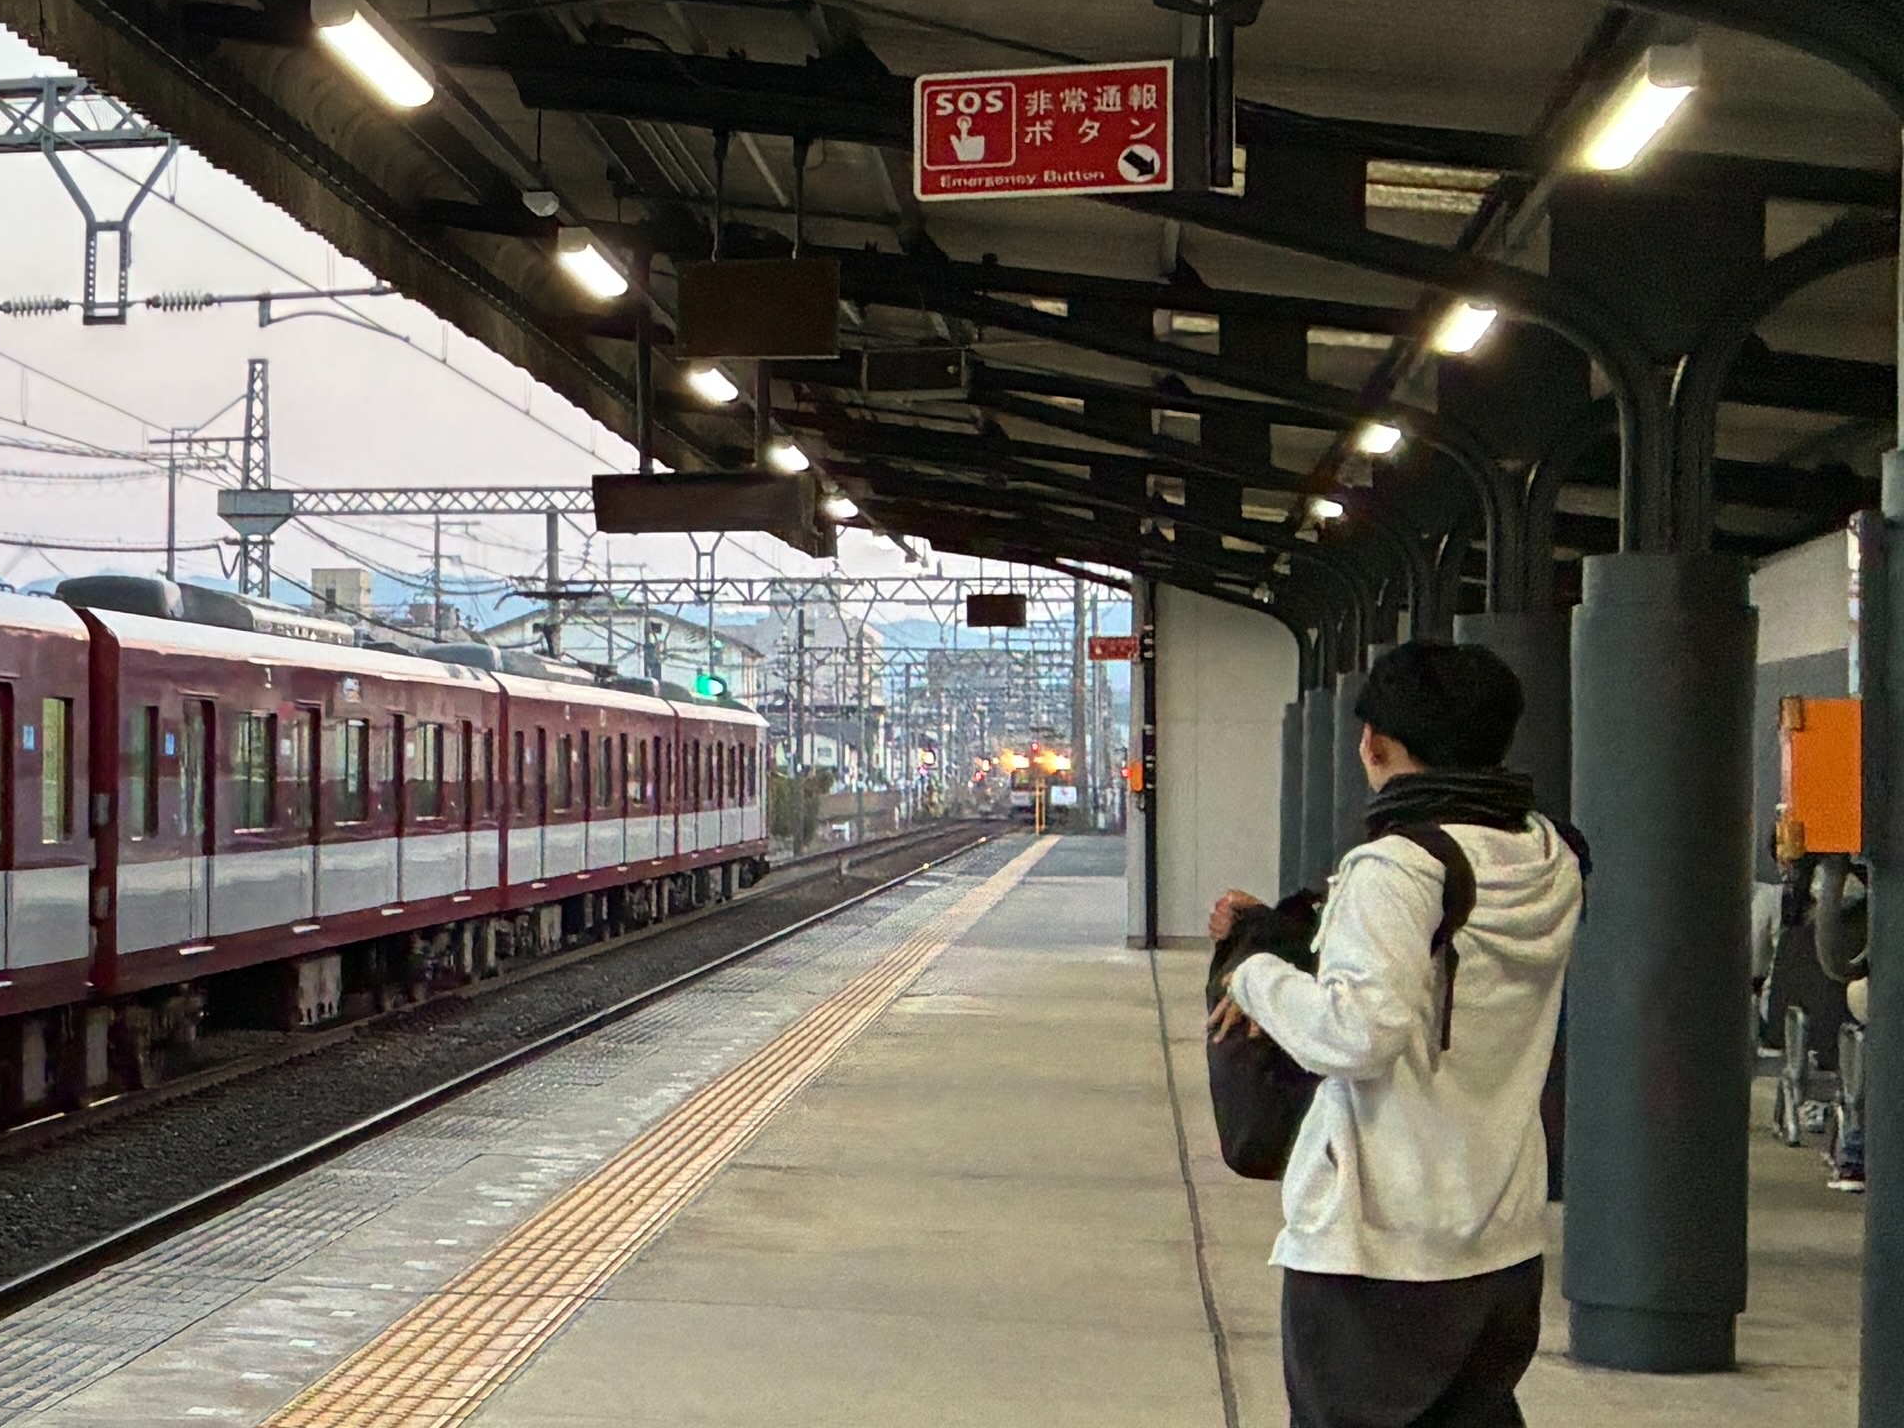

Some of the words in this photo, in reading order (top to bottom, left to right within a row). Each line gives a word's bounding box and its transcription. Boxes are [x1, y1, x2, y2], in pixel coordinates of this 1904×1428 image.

[935, 90, 1004, 116] SOS
[1024, 84, 1158, 117] 非常通報
[1023, 119, 1156, 146] ボタン
[940, 175, 1036, 188] Emergency
[1043, 169, 1105, 183] Button
